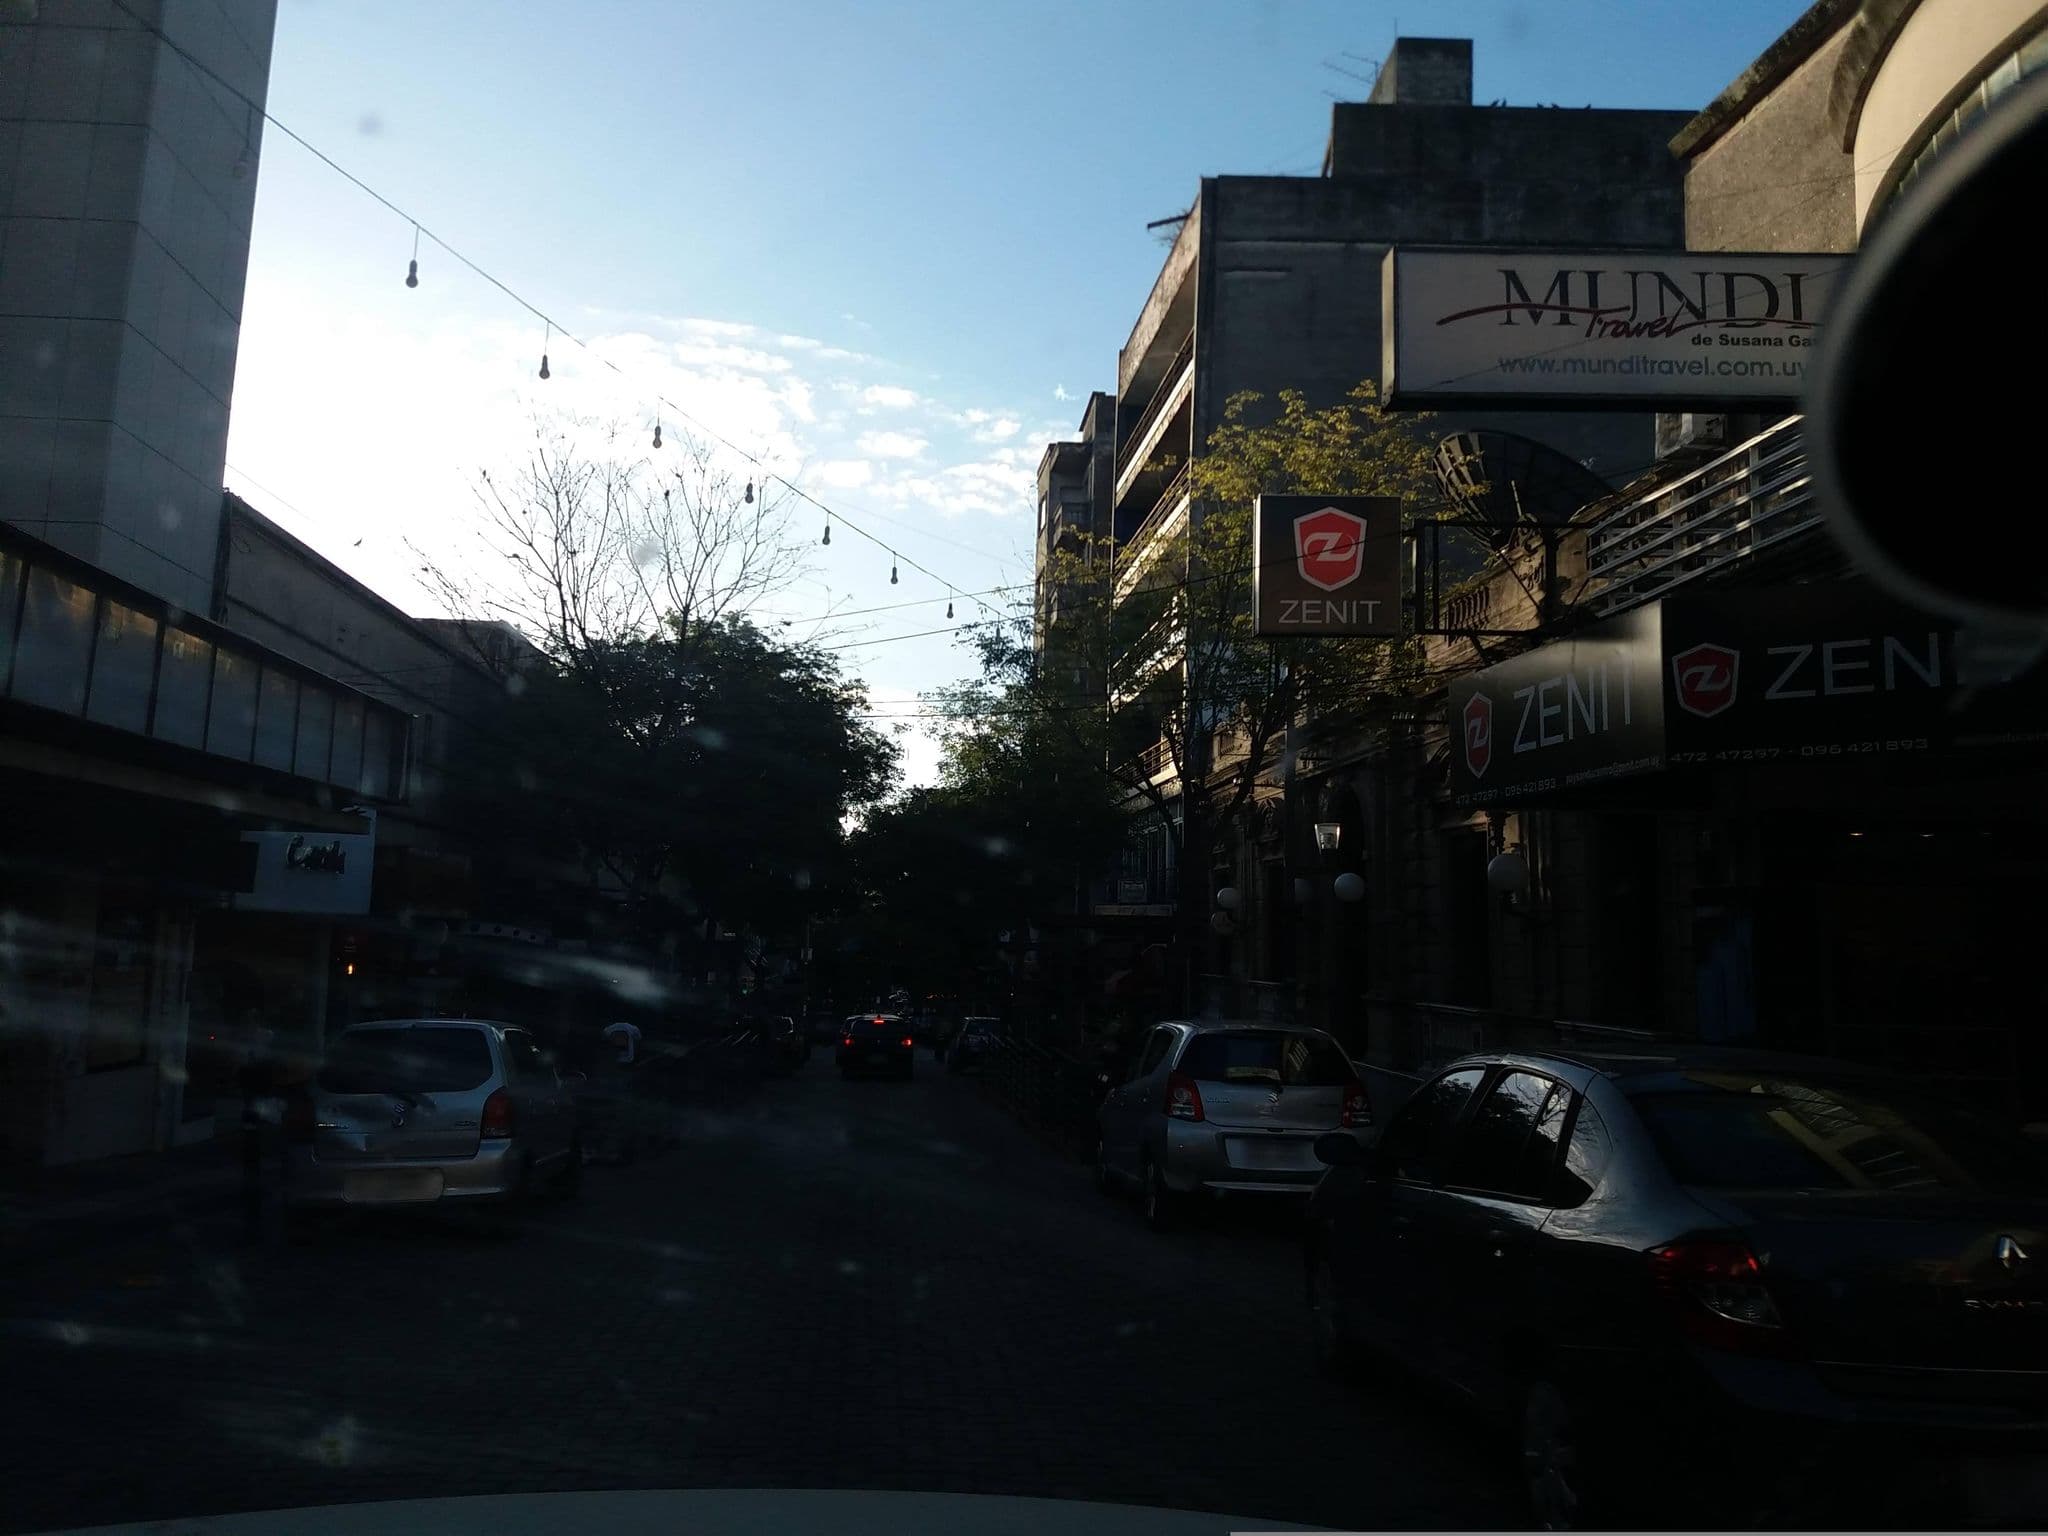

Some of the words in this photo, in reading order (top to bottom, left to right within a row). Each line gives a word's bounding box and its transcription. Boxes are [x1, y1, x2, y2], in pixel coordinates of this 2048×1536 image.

[1499, 269, 1809, 329] MUNDI
[1584, 301, 1690, 339] Travel
[1691, 333, 1713, 346] de
[1719, 334, 1783, 347] Susana
[1278, 600, 1382, 625] ZENIT
